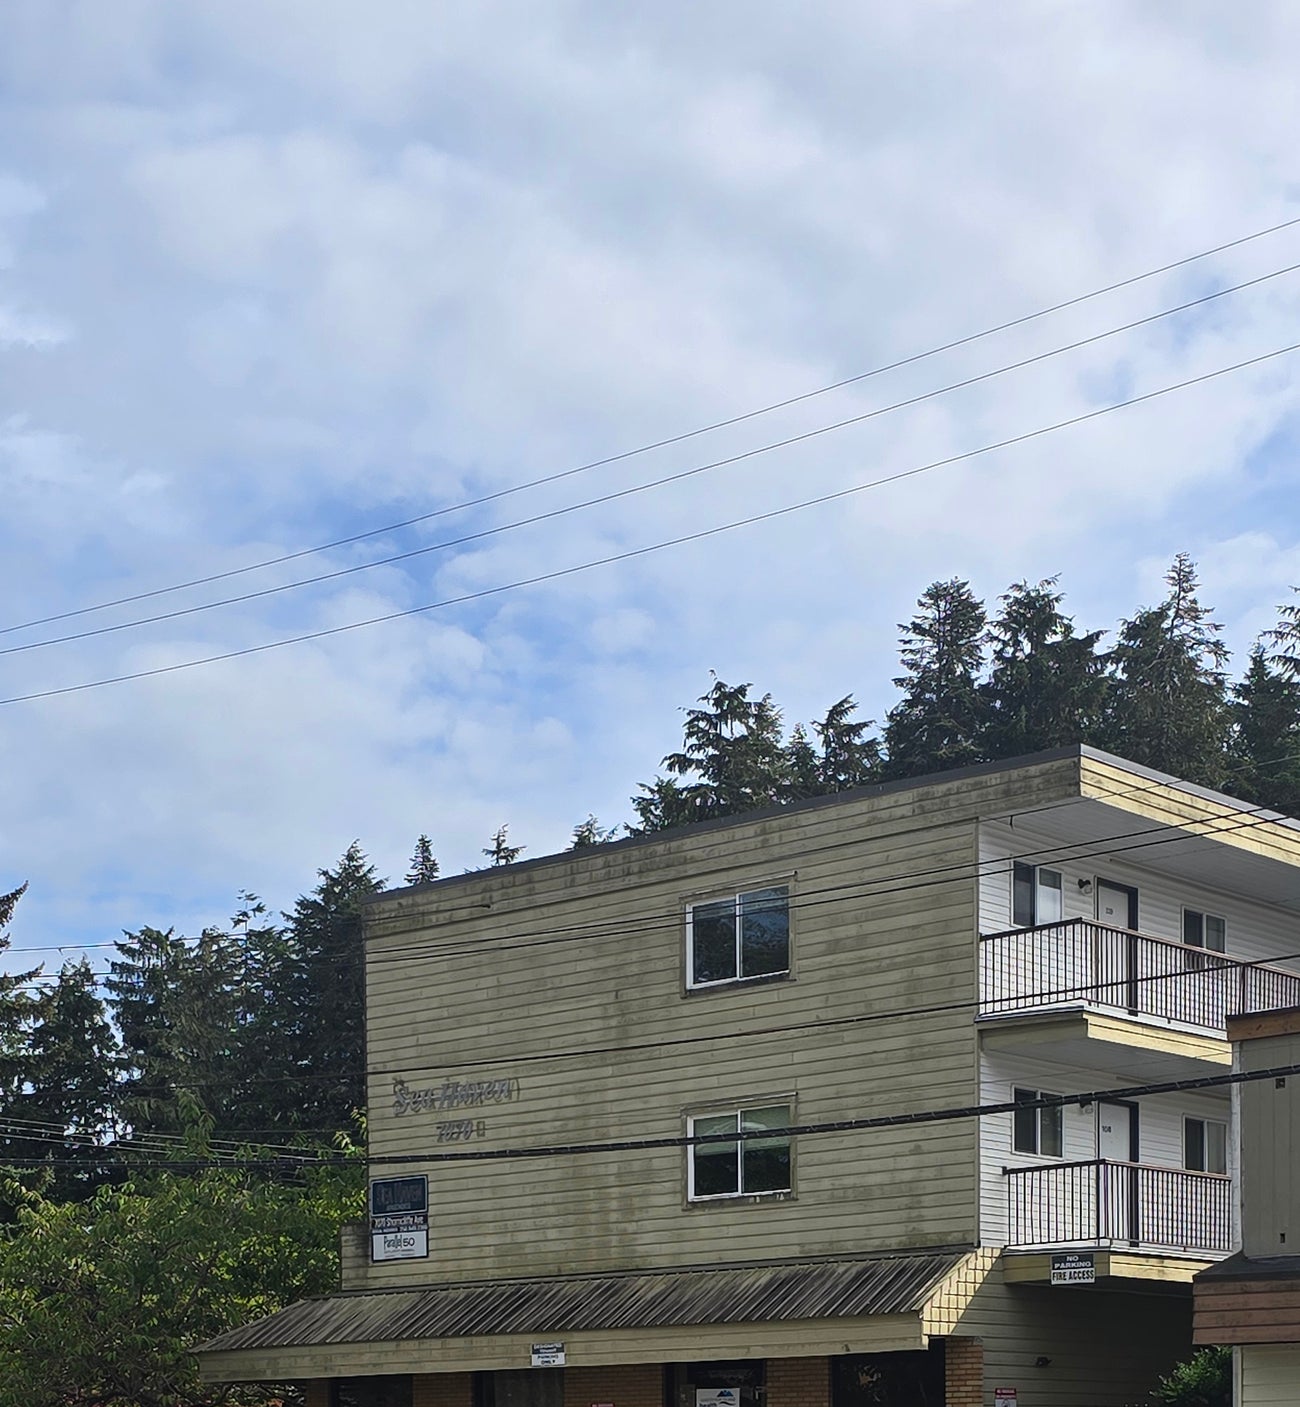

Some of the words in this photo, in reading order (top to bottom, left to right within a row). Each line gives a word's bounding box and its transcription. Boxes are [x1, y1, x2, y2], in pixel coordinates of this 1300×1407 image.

[402, 1237, 415, 1247] 50
[1054, 1261, 1092, 1269] PARKING
[1053, 1271, 1067, 1281] FIRE
[1069, 1270, 1094, 1280] ACCESS
